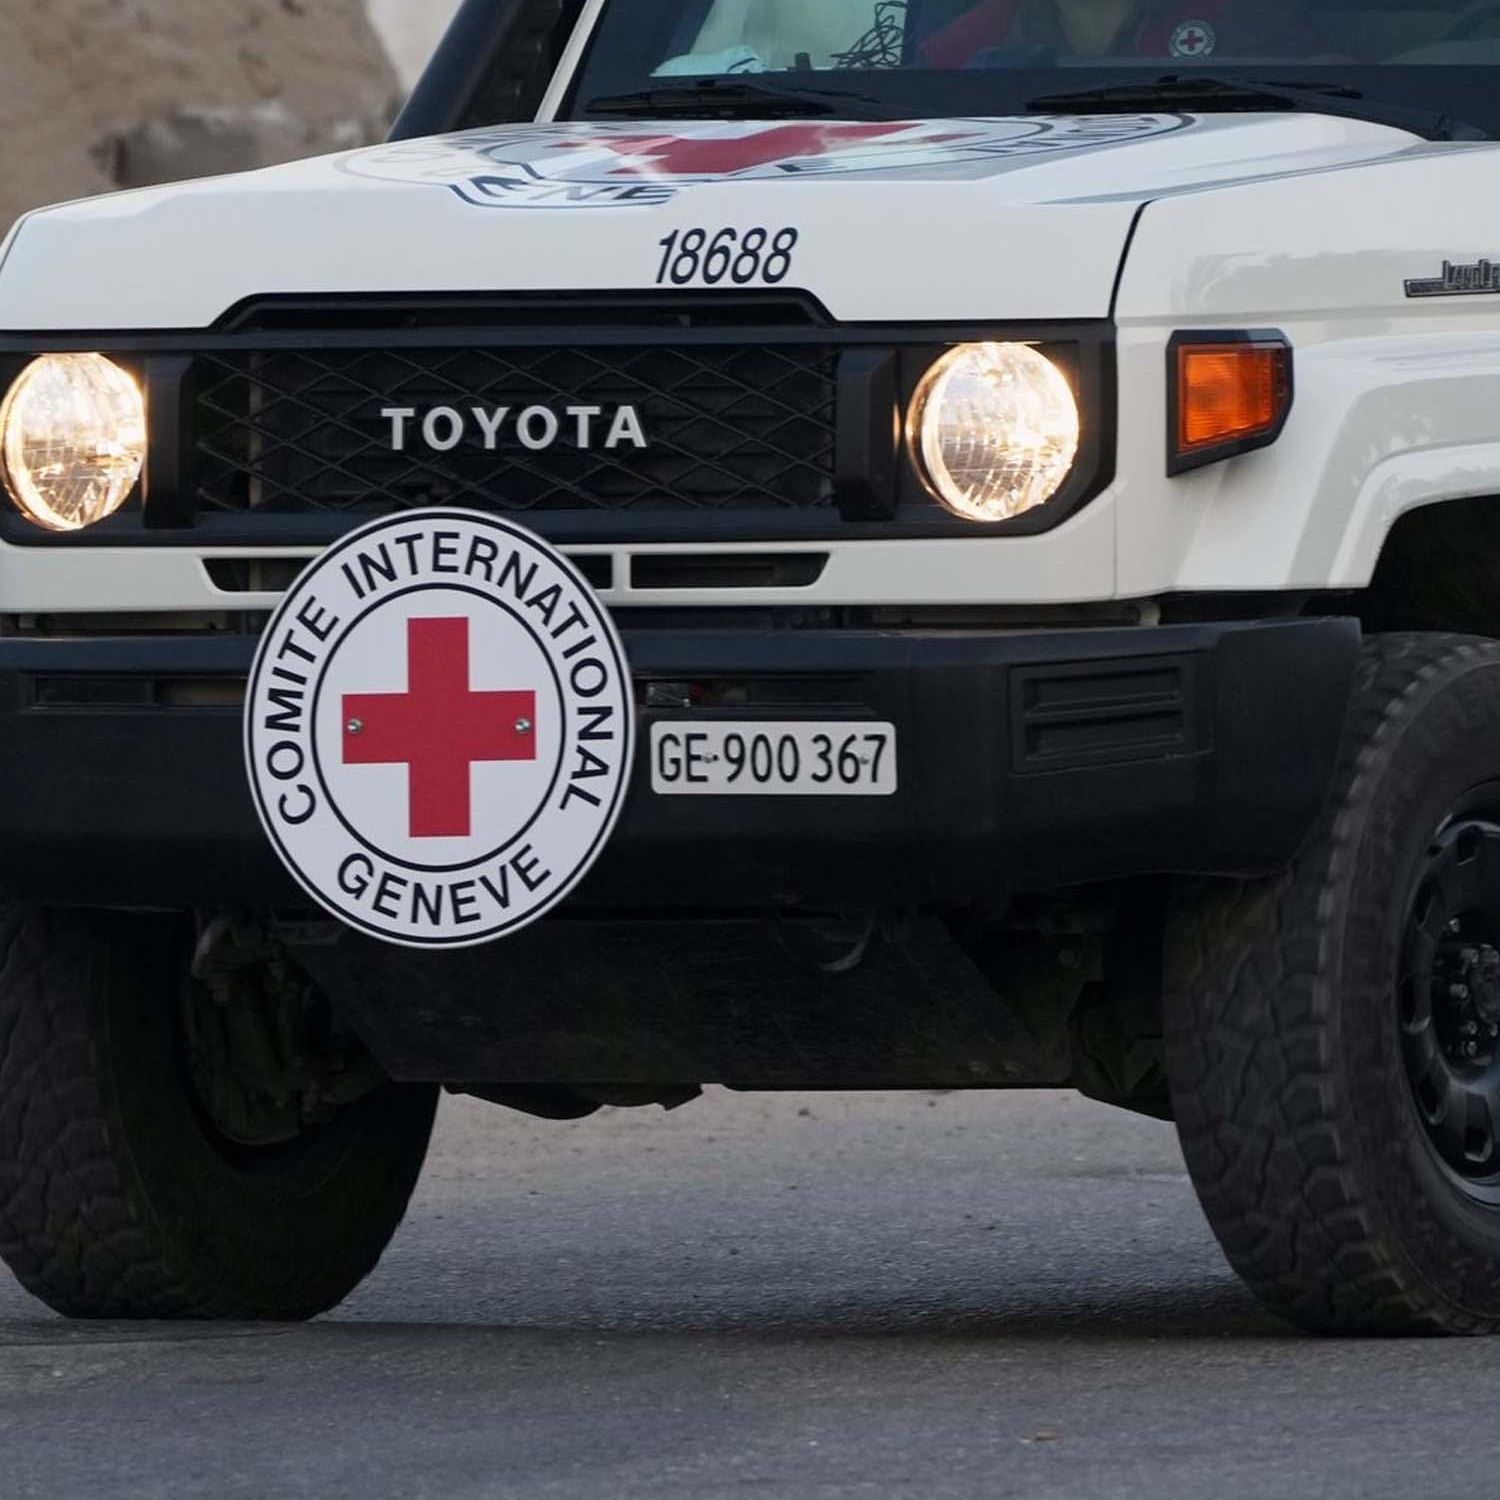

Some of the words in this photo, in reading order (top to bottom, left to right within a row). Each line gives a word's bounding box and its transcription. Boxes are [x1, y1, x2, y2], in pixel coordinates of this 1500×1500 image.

[655, 227, 799, 285] 18688
[380, 404, 648, 451] TOYOTA
[264, 596, 340, 825] COMITE
[341, 531, 614, 813] INTERNATIONAL
[335, 843, 551, 926] GENEVE
